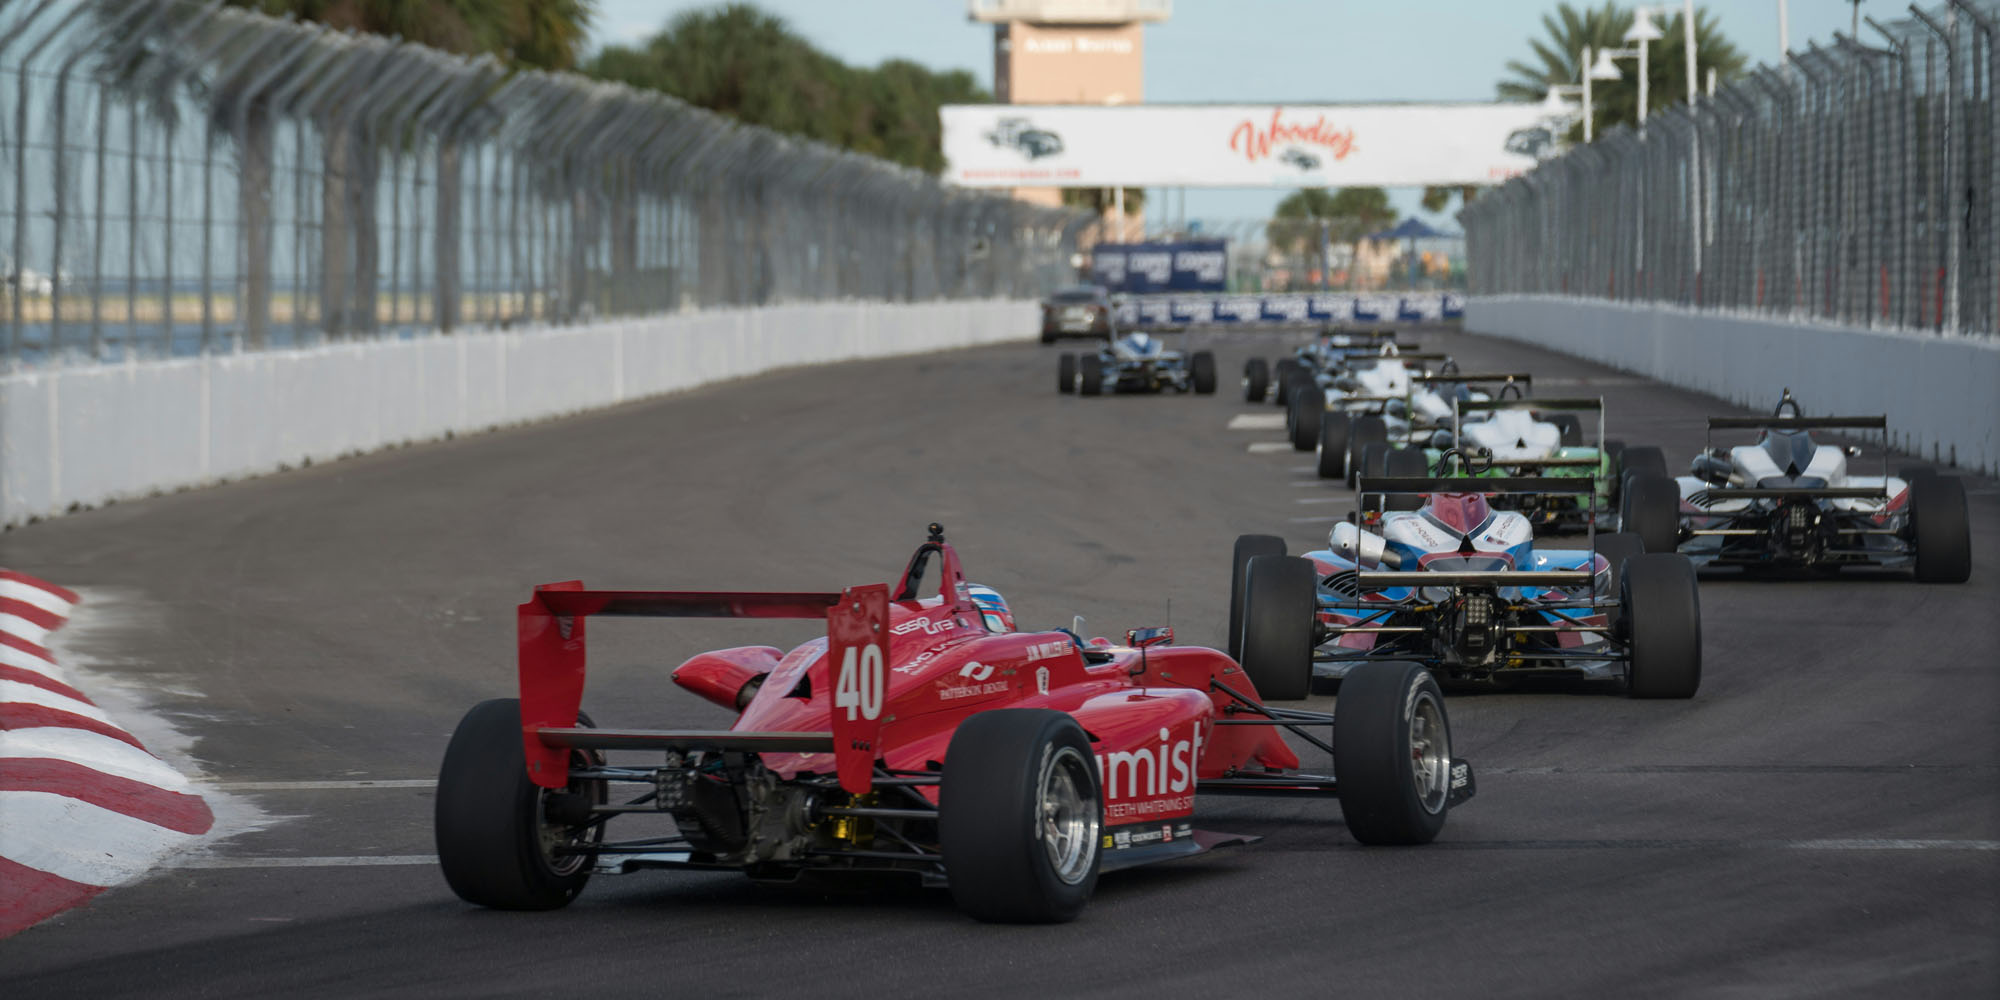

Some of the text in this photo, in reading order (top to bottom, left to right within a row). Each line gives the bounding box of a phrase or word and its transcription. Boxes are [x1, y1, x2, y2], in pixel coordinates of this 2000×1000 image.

[835, 643, 883, 721] 40
[940, 685, 982, 700] PATTERSON
[1096, 721, 1203, 799] mist
[1108, 803, 1137, 817] TEETH
[1136, 797, 1183, 815] WHITENING
